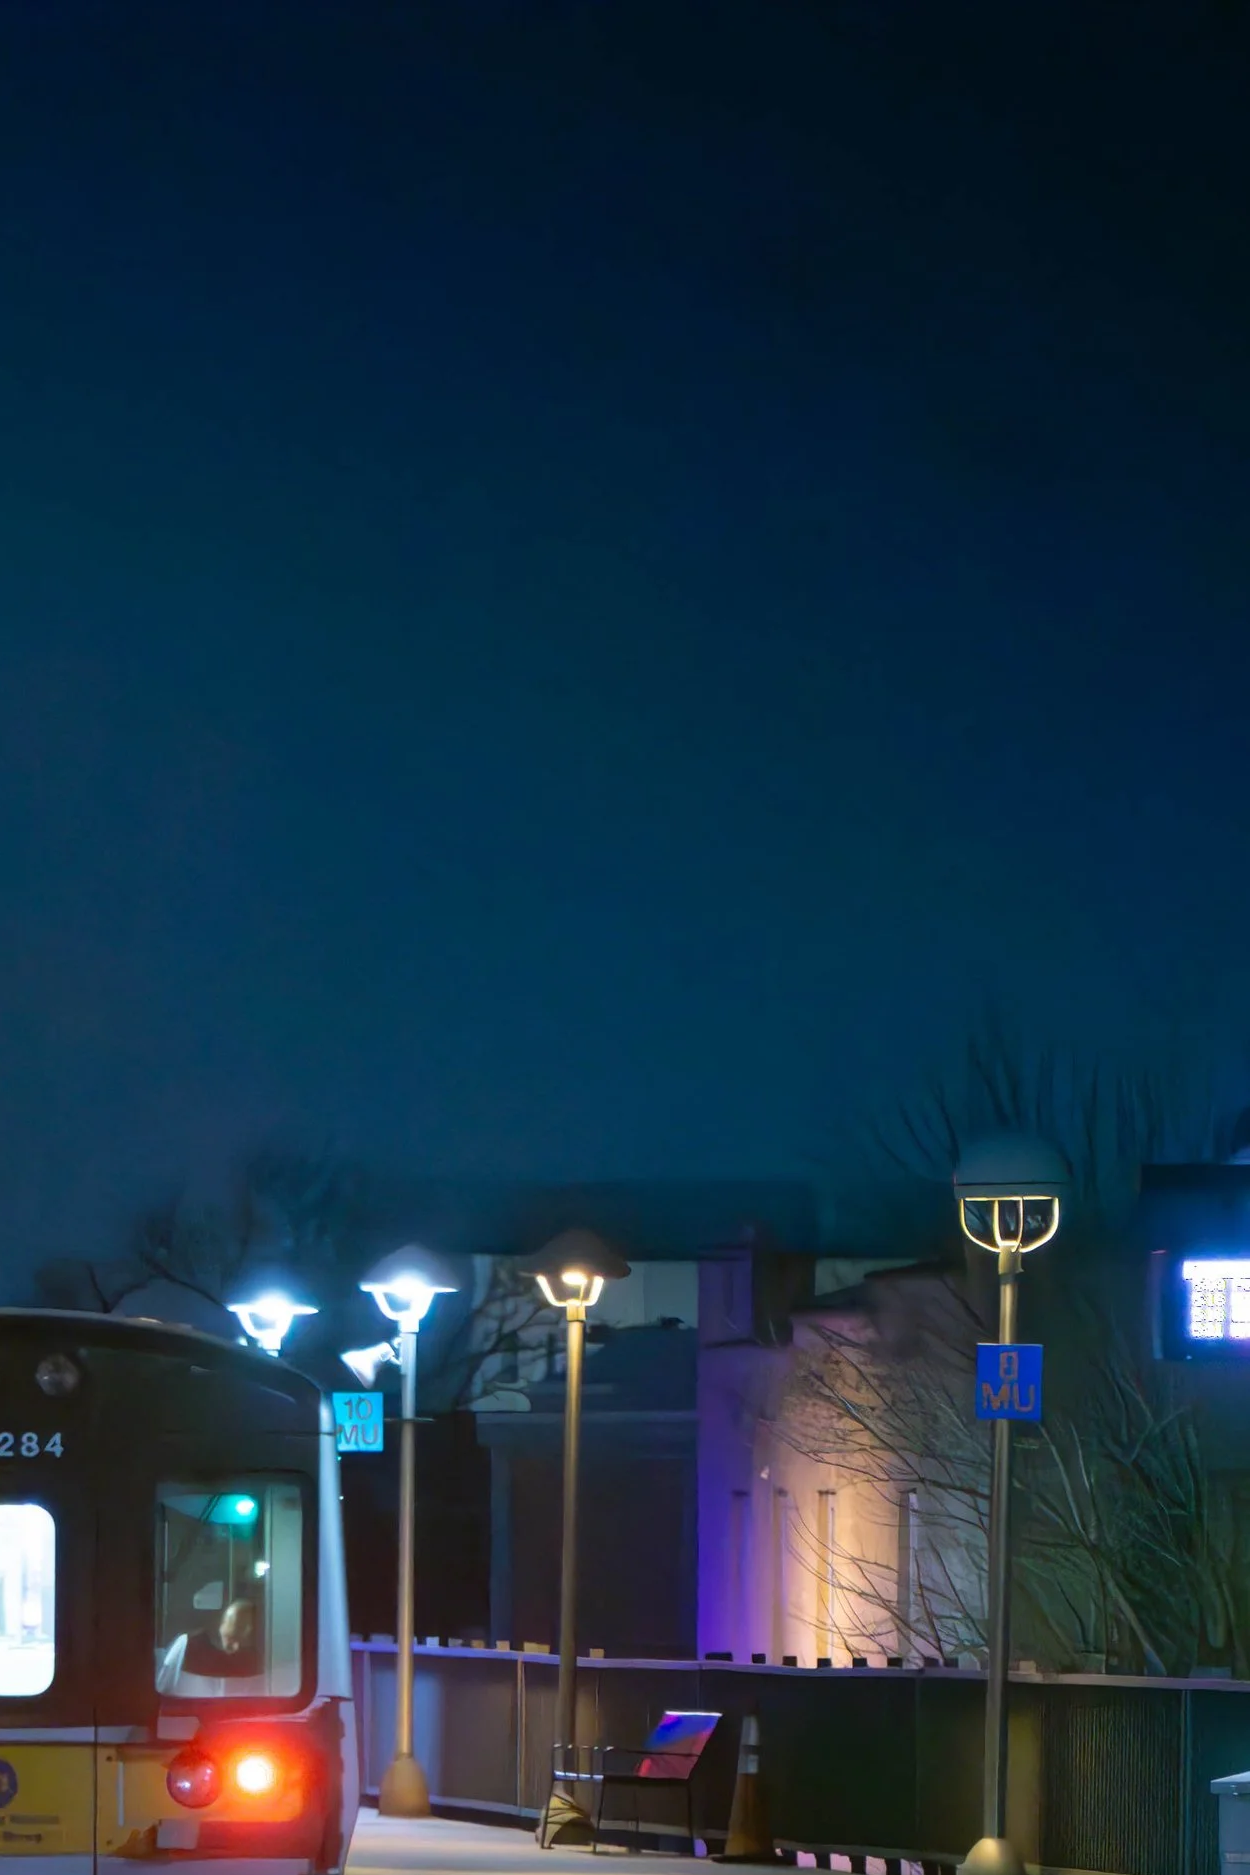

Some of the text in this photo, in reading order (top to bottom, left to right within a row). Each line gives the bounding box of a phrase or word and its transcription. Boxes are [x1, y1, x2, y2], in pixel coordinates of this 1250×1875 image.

[344, 1397, 372, 1420] 10
[982, 1383, 1035, 1412] MU
[337, 1424, 379, 1445] MU
